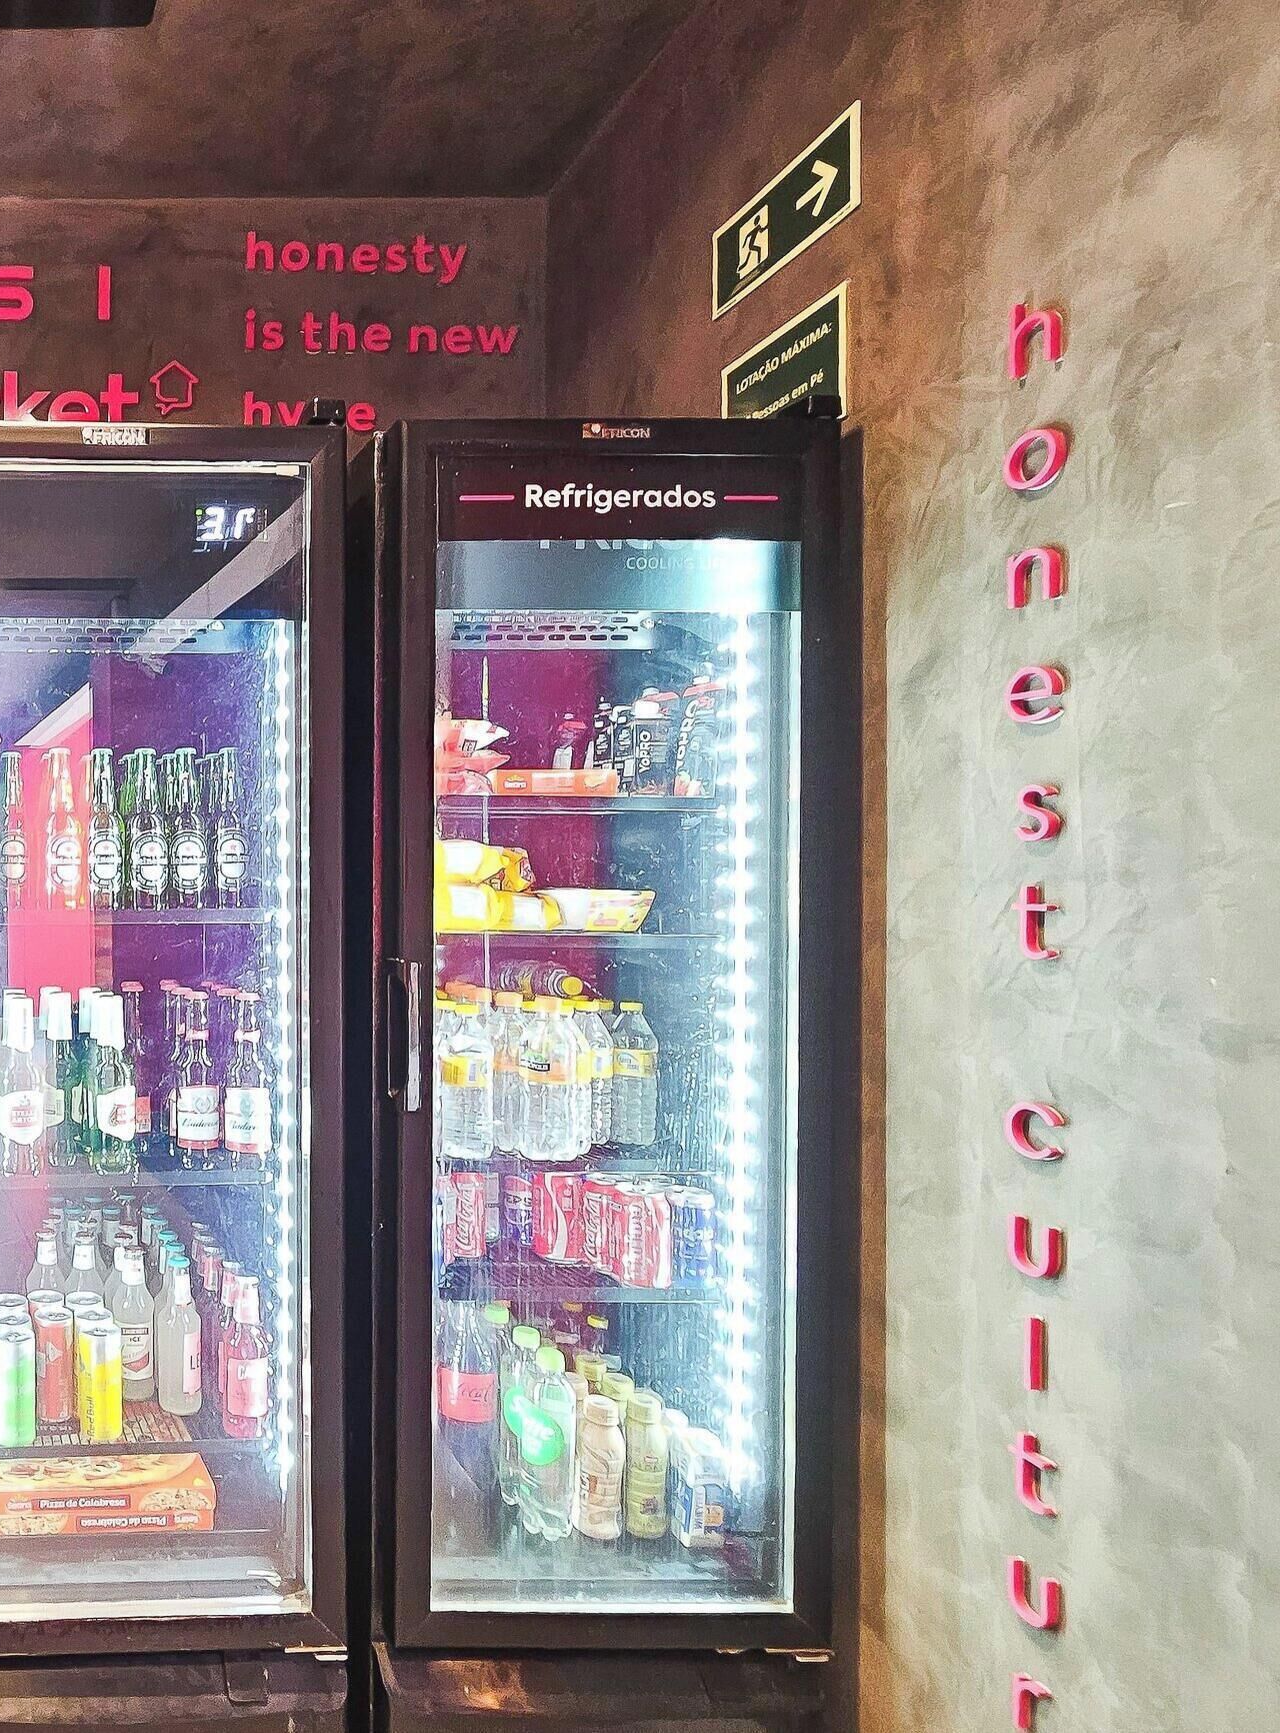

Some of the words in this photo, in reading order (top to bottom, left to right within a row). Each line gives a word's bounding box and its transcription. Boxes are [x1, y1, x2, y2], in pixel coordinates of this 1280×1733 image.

[245, 230, 468, 286] honesty
[244, 308, 284, 352] is
[300, 311, 392, 354] the
[407, 324, 519, 354] new
[736, 356, 780, 395] LOTAÇÃO
[780, 322, 833, 365] MÁXIMA:
[791, 381, 808, 399] em
[810, 368, 824, 388] Pé
[243, 391, 376, 432] hye
[524, 483, 717, 514] Refrigerados
[1002, 302, 1069, 961] honest
